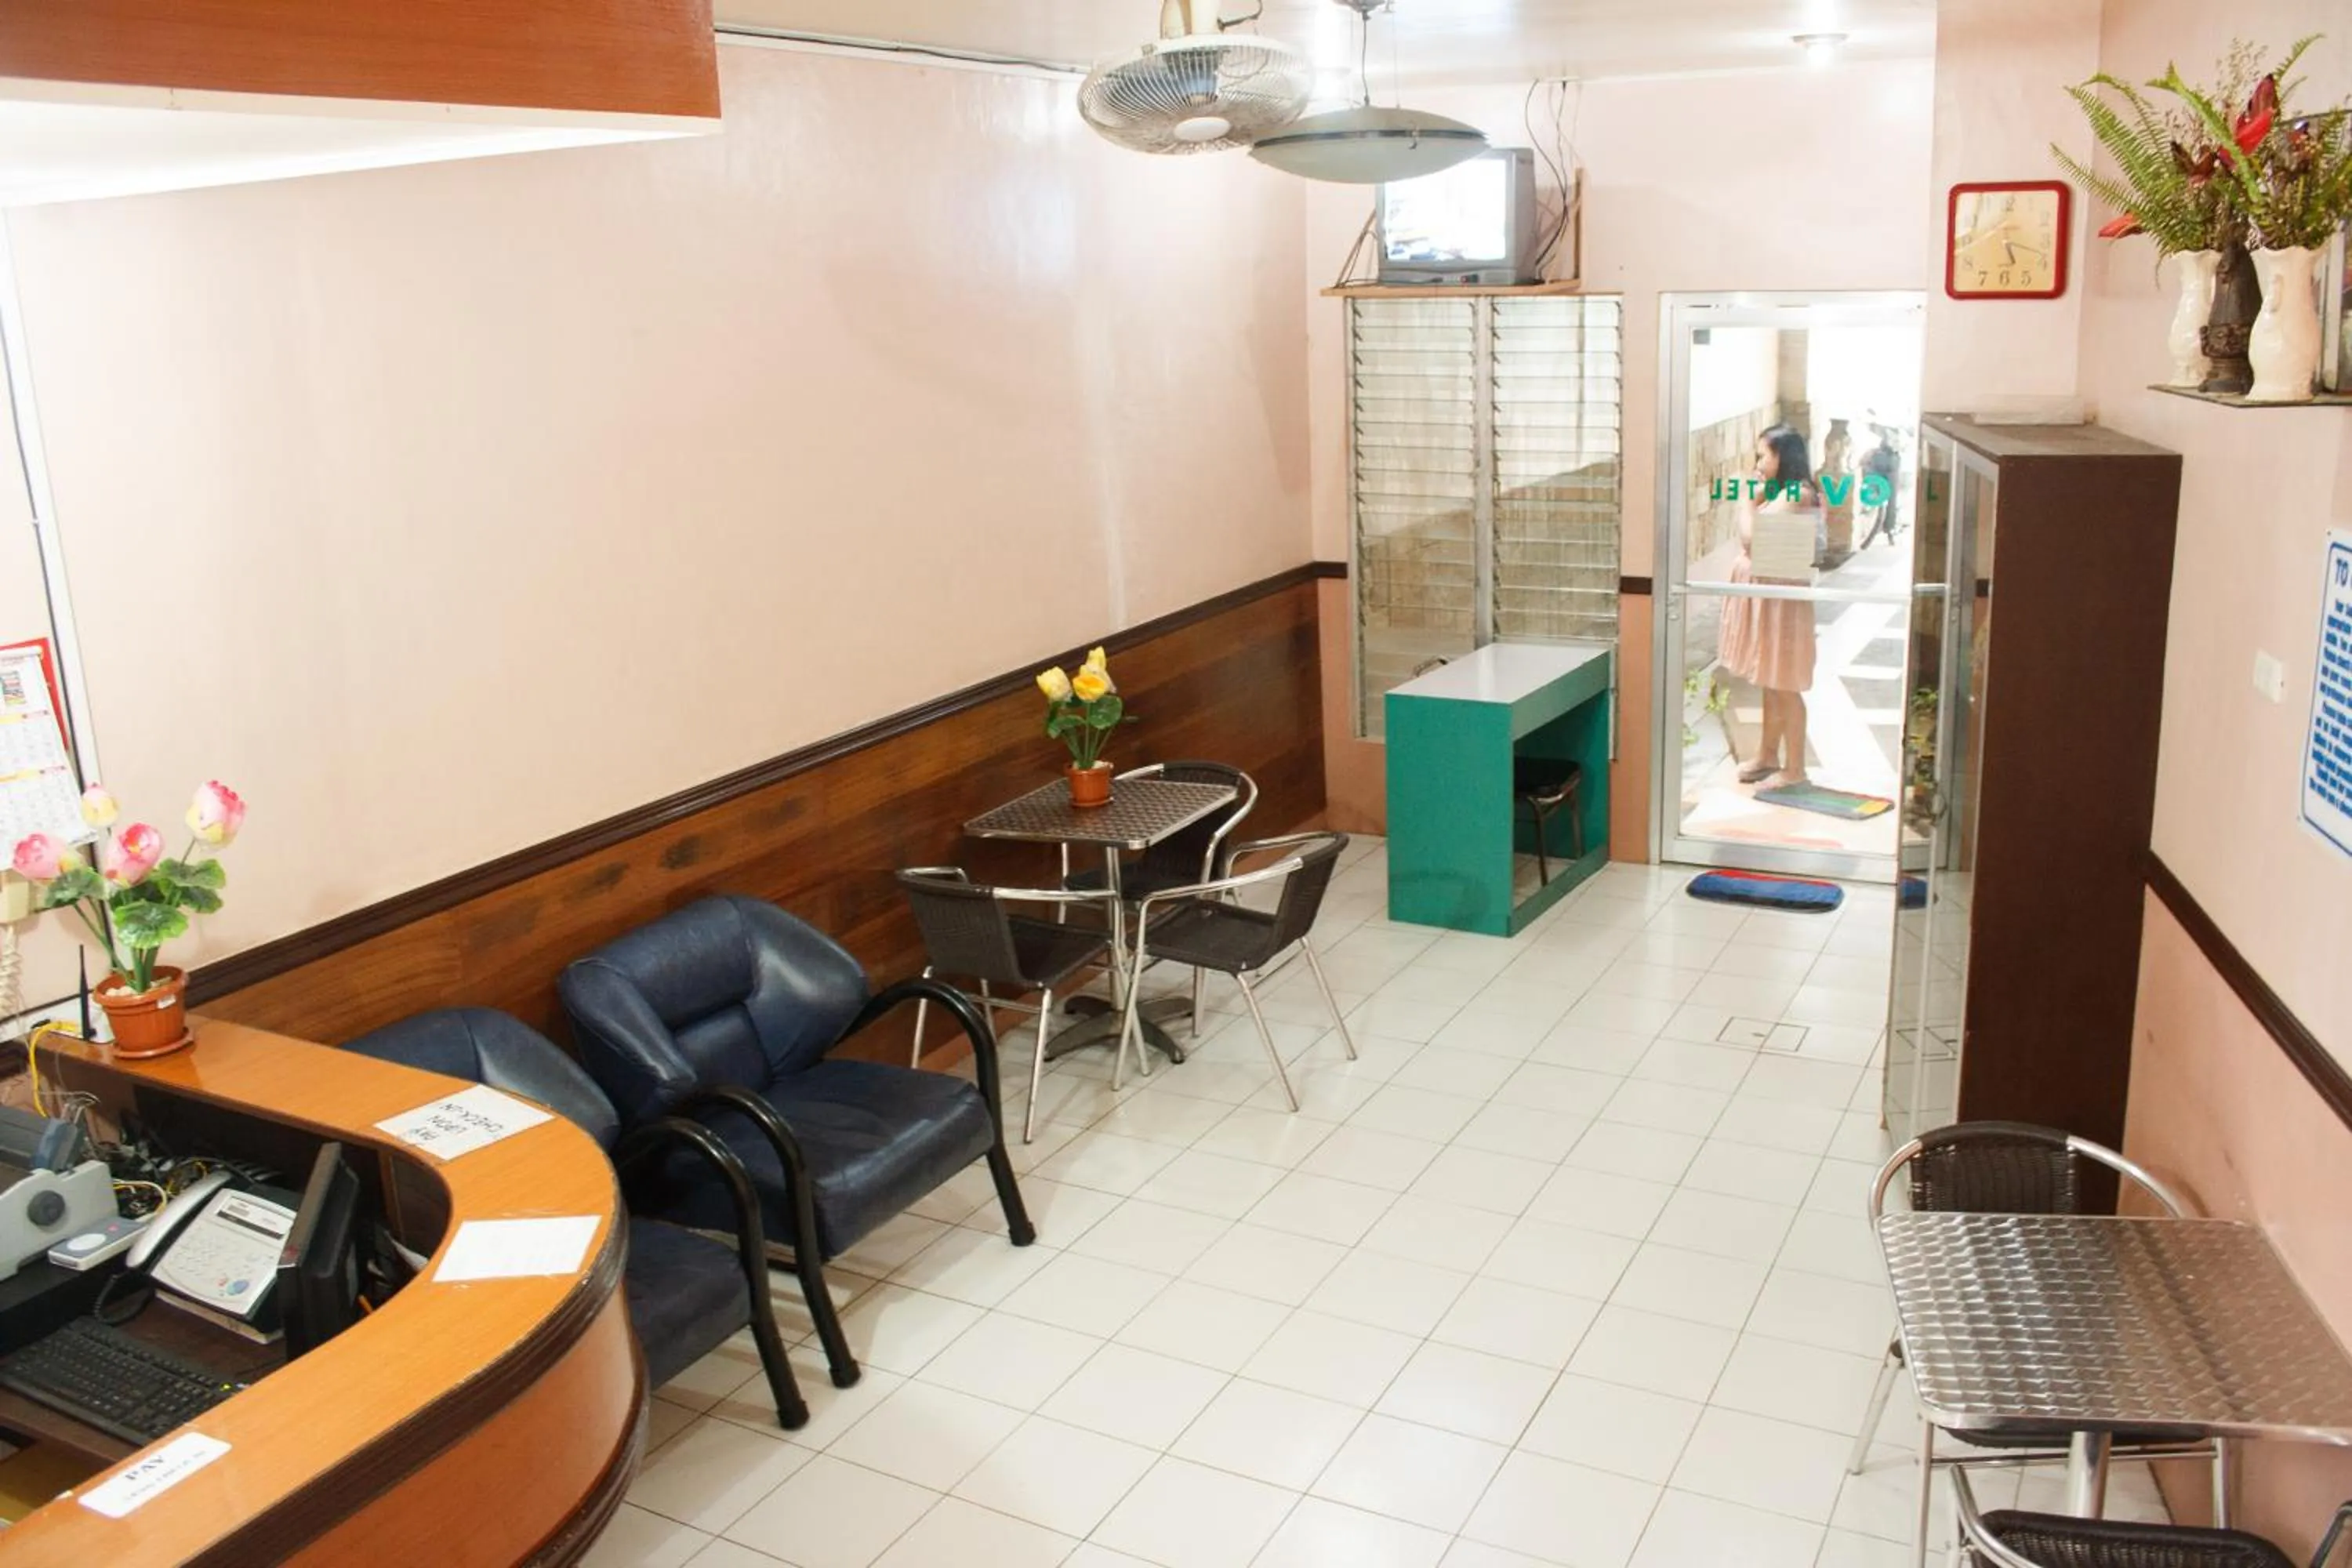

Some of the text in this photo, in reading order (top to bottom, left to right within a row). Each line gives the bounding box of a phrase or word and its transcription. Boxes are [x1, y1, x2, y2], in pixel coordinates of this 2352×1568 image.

[1978, 270, 2032, 286] 7 6 5
[2336, 557, 2348, 587] TO
[125, 1455, 163, 1480] PAY
